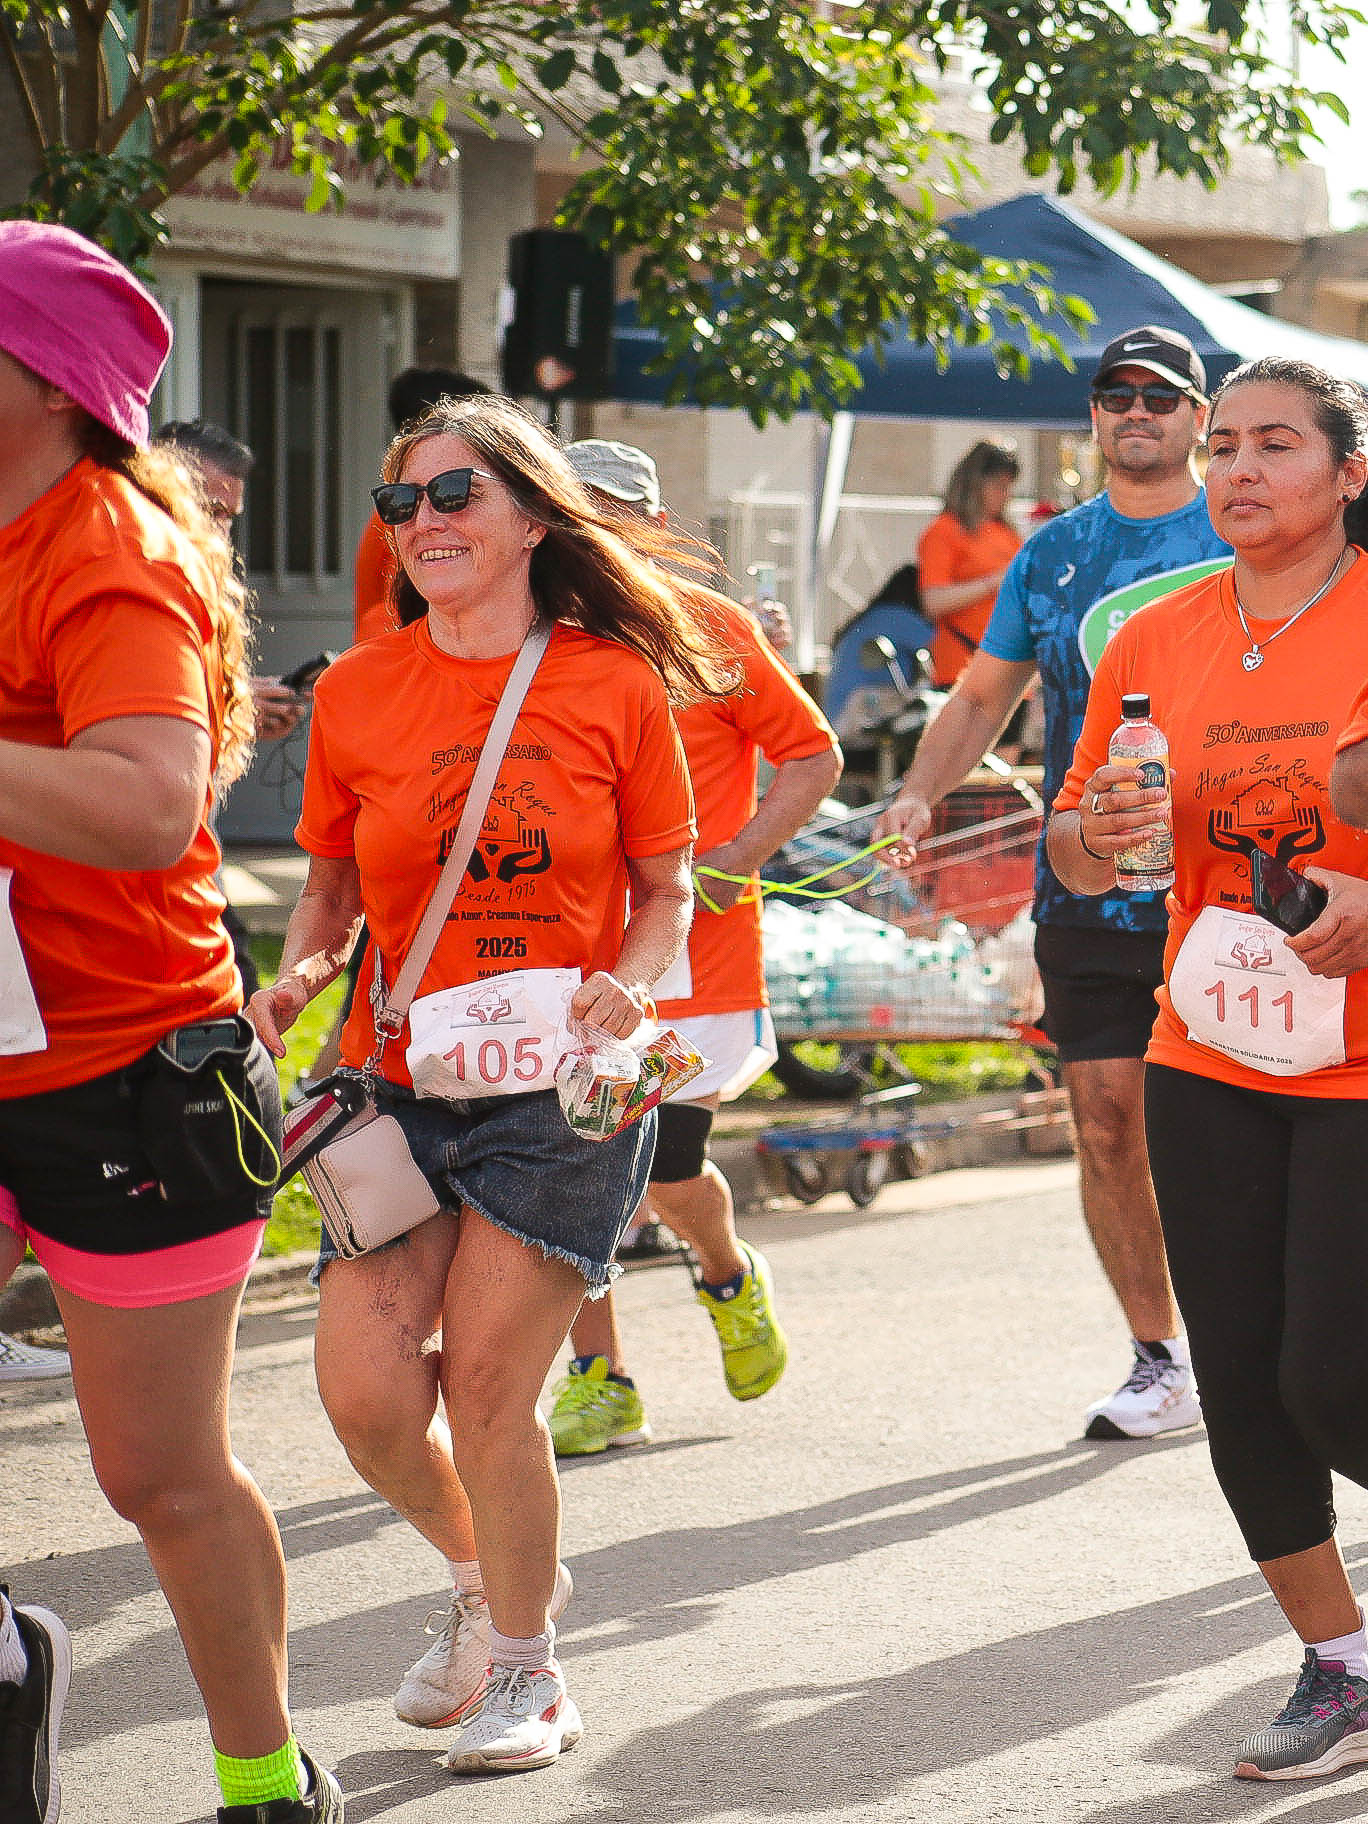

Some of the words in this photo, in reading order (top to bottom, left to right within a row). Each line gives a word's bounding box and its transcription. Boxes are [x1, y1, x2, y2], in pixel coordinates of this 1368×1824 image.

[475, 936, 528, 959] 2025
[1204, 980, 1294, 1032] 111
[443, 1037, 544, 1084] 105
